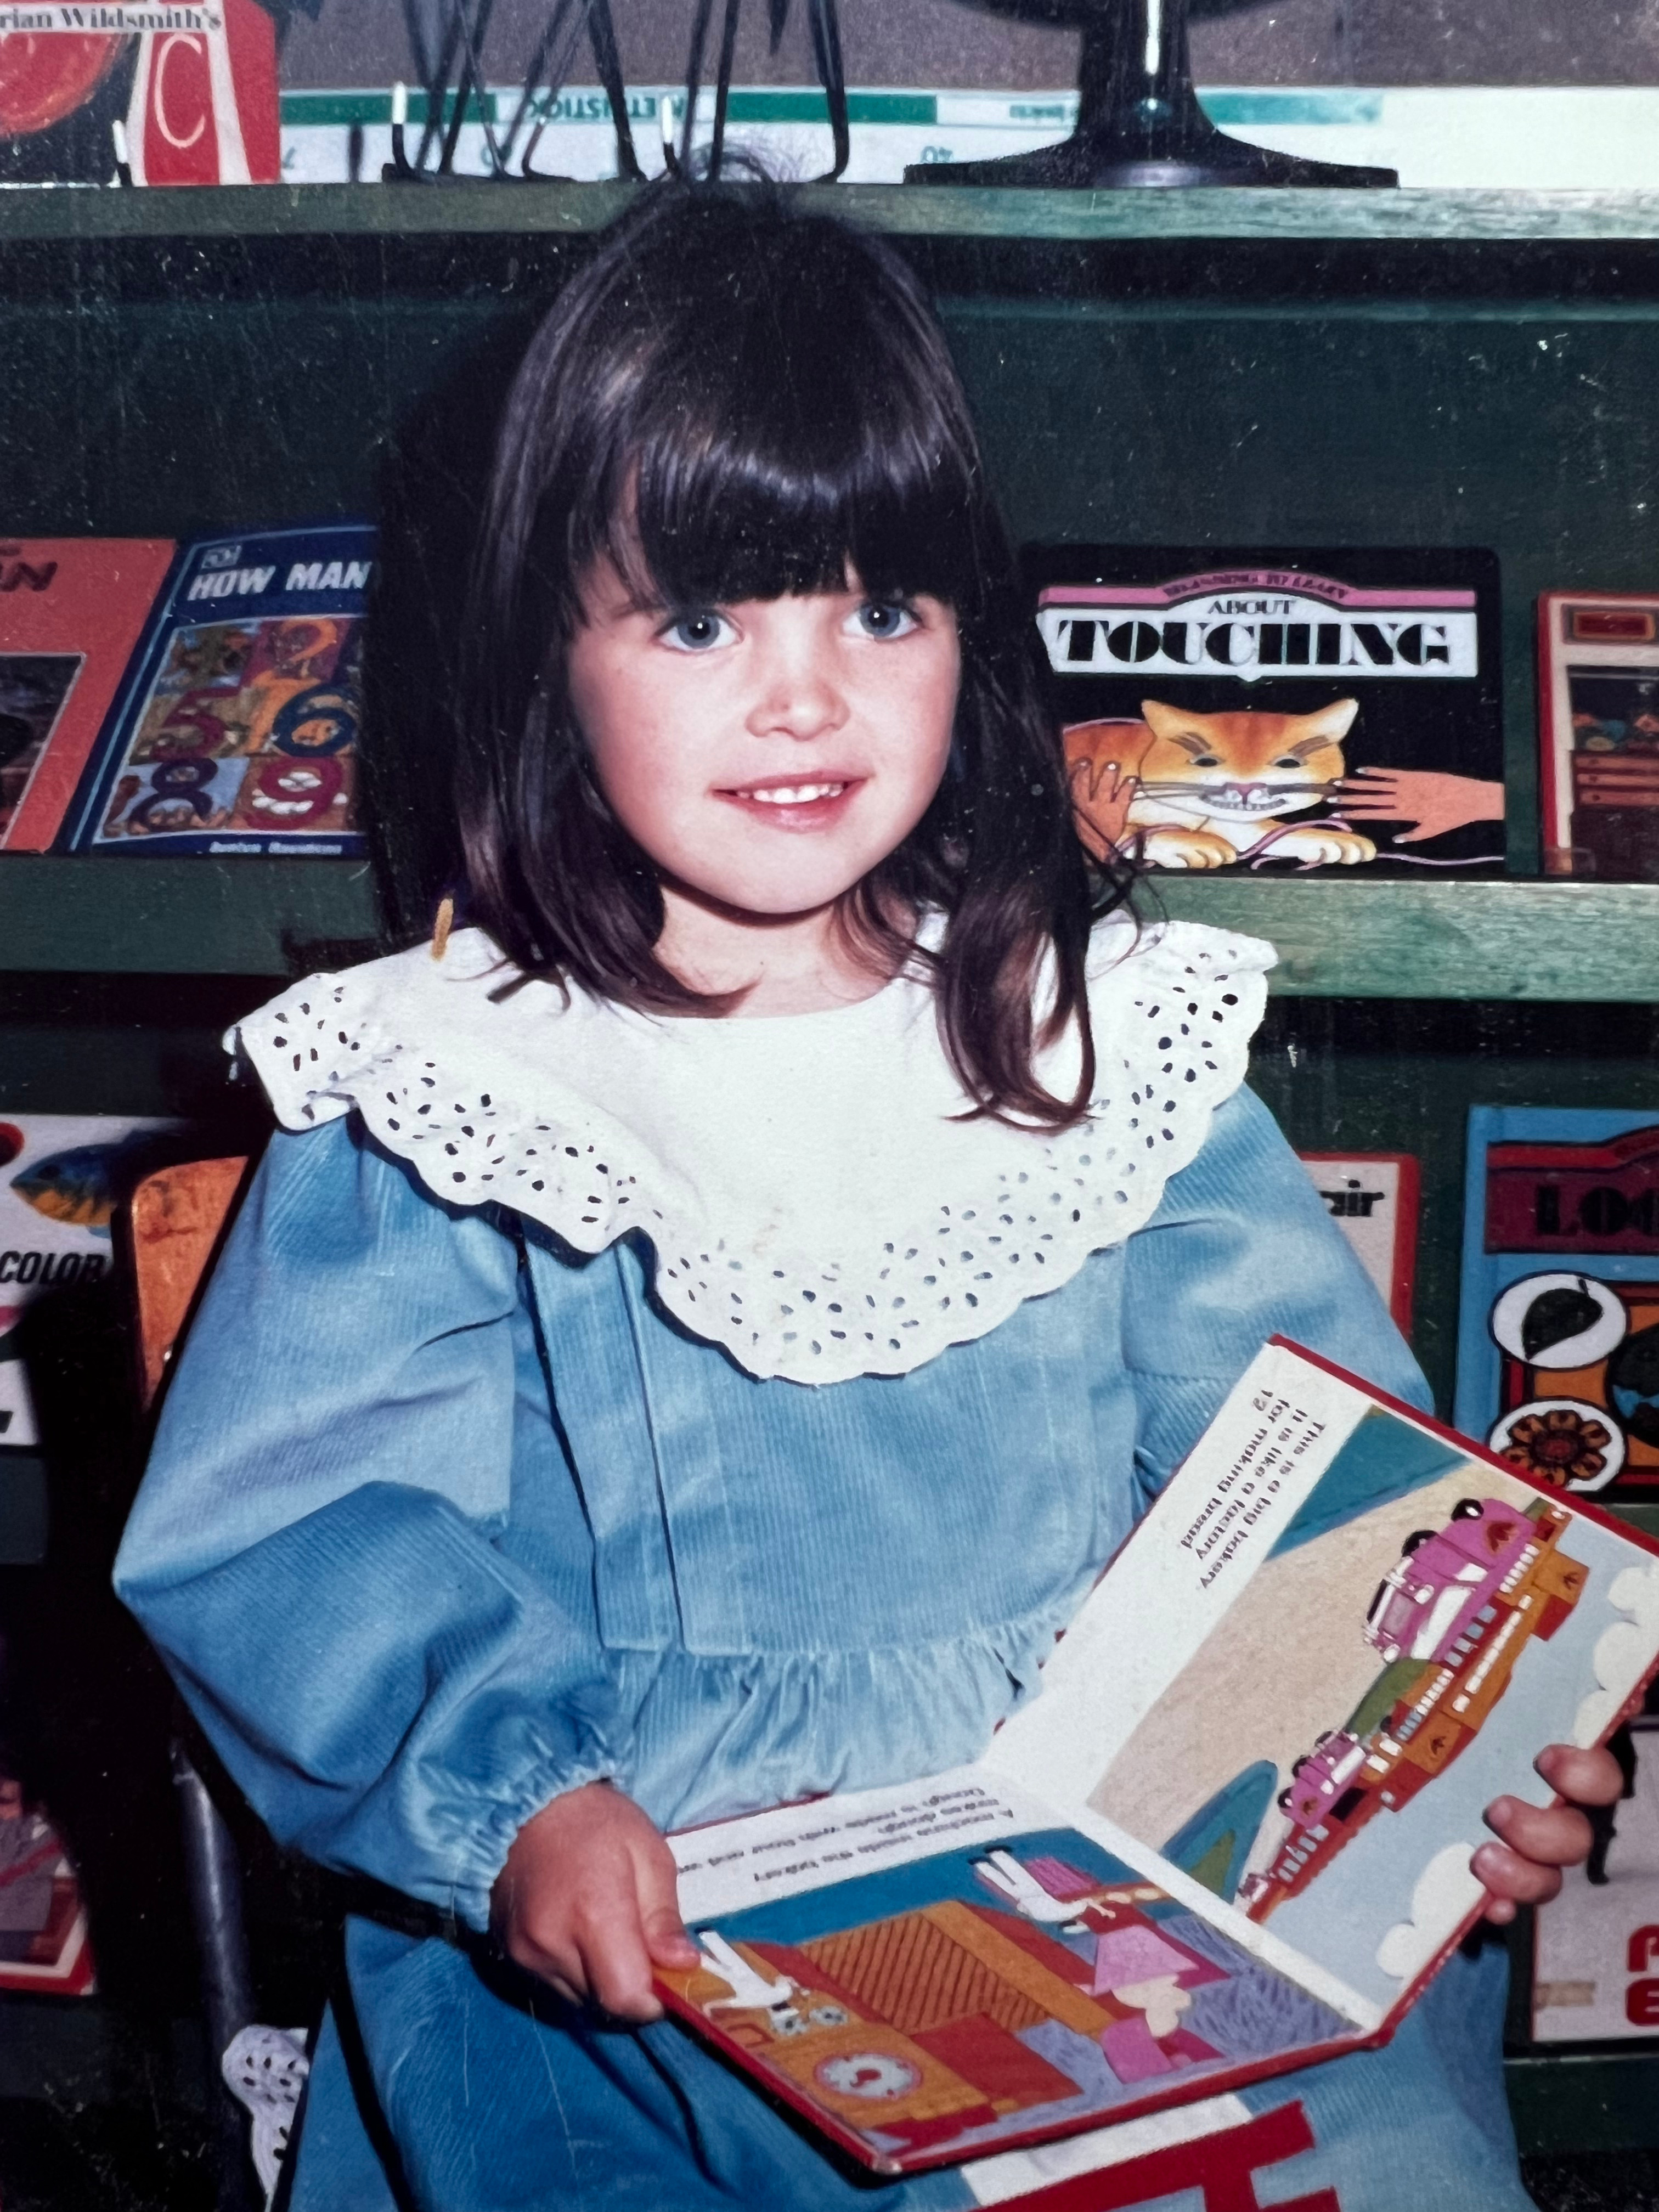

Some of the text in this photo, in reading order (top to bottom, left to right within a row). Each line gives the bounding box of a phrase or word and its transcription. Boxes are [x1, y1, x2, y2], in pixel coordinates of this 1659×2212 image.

[61, 8, 221, 30] Wildsmith's
[187, 565, 276, 601] HOW
[1208, 599, 1296, 614] ABOUT
[1057, 619, 1450, 665] TOUCHING
[0, 1250, 108, 1284] COLOR
[1293, 1421, 1326, 1455] This
[1241, 1482, 1255, 1495] a
[1267, 1480, 1280, 1493] a
[1243, 1497, 1271, 1525] big
